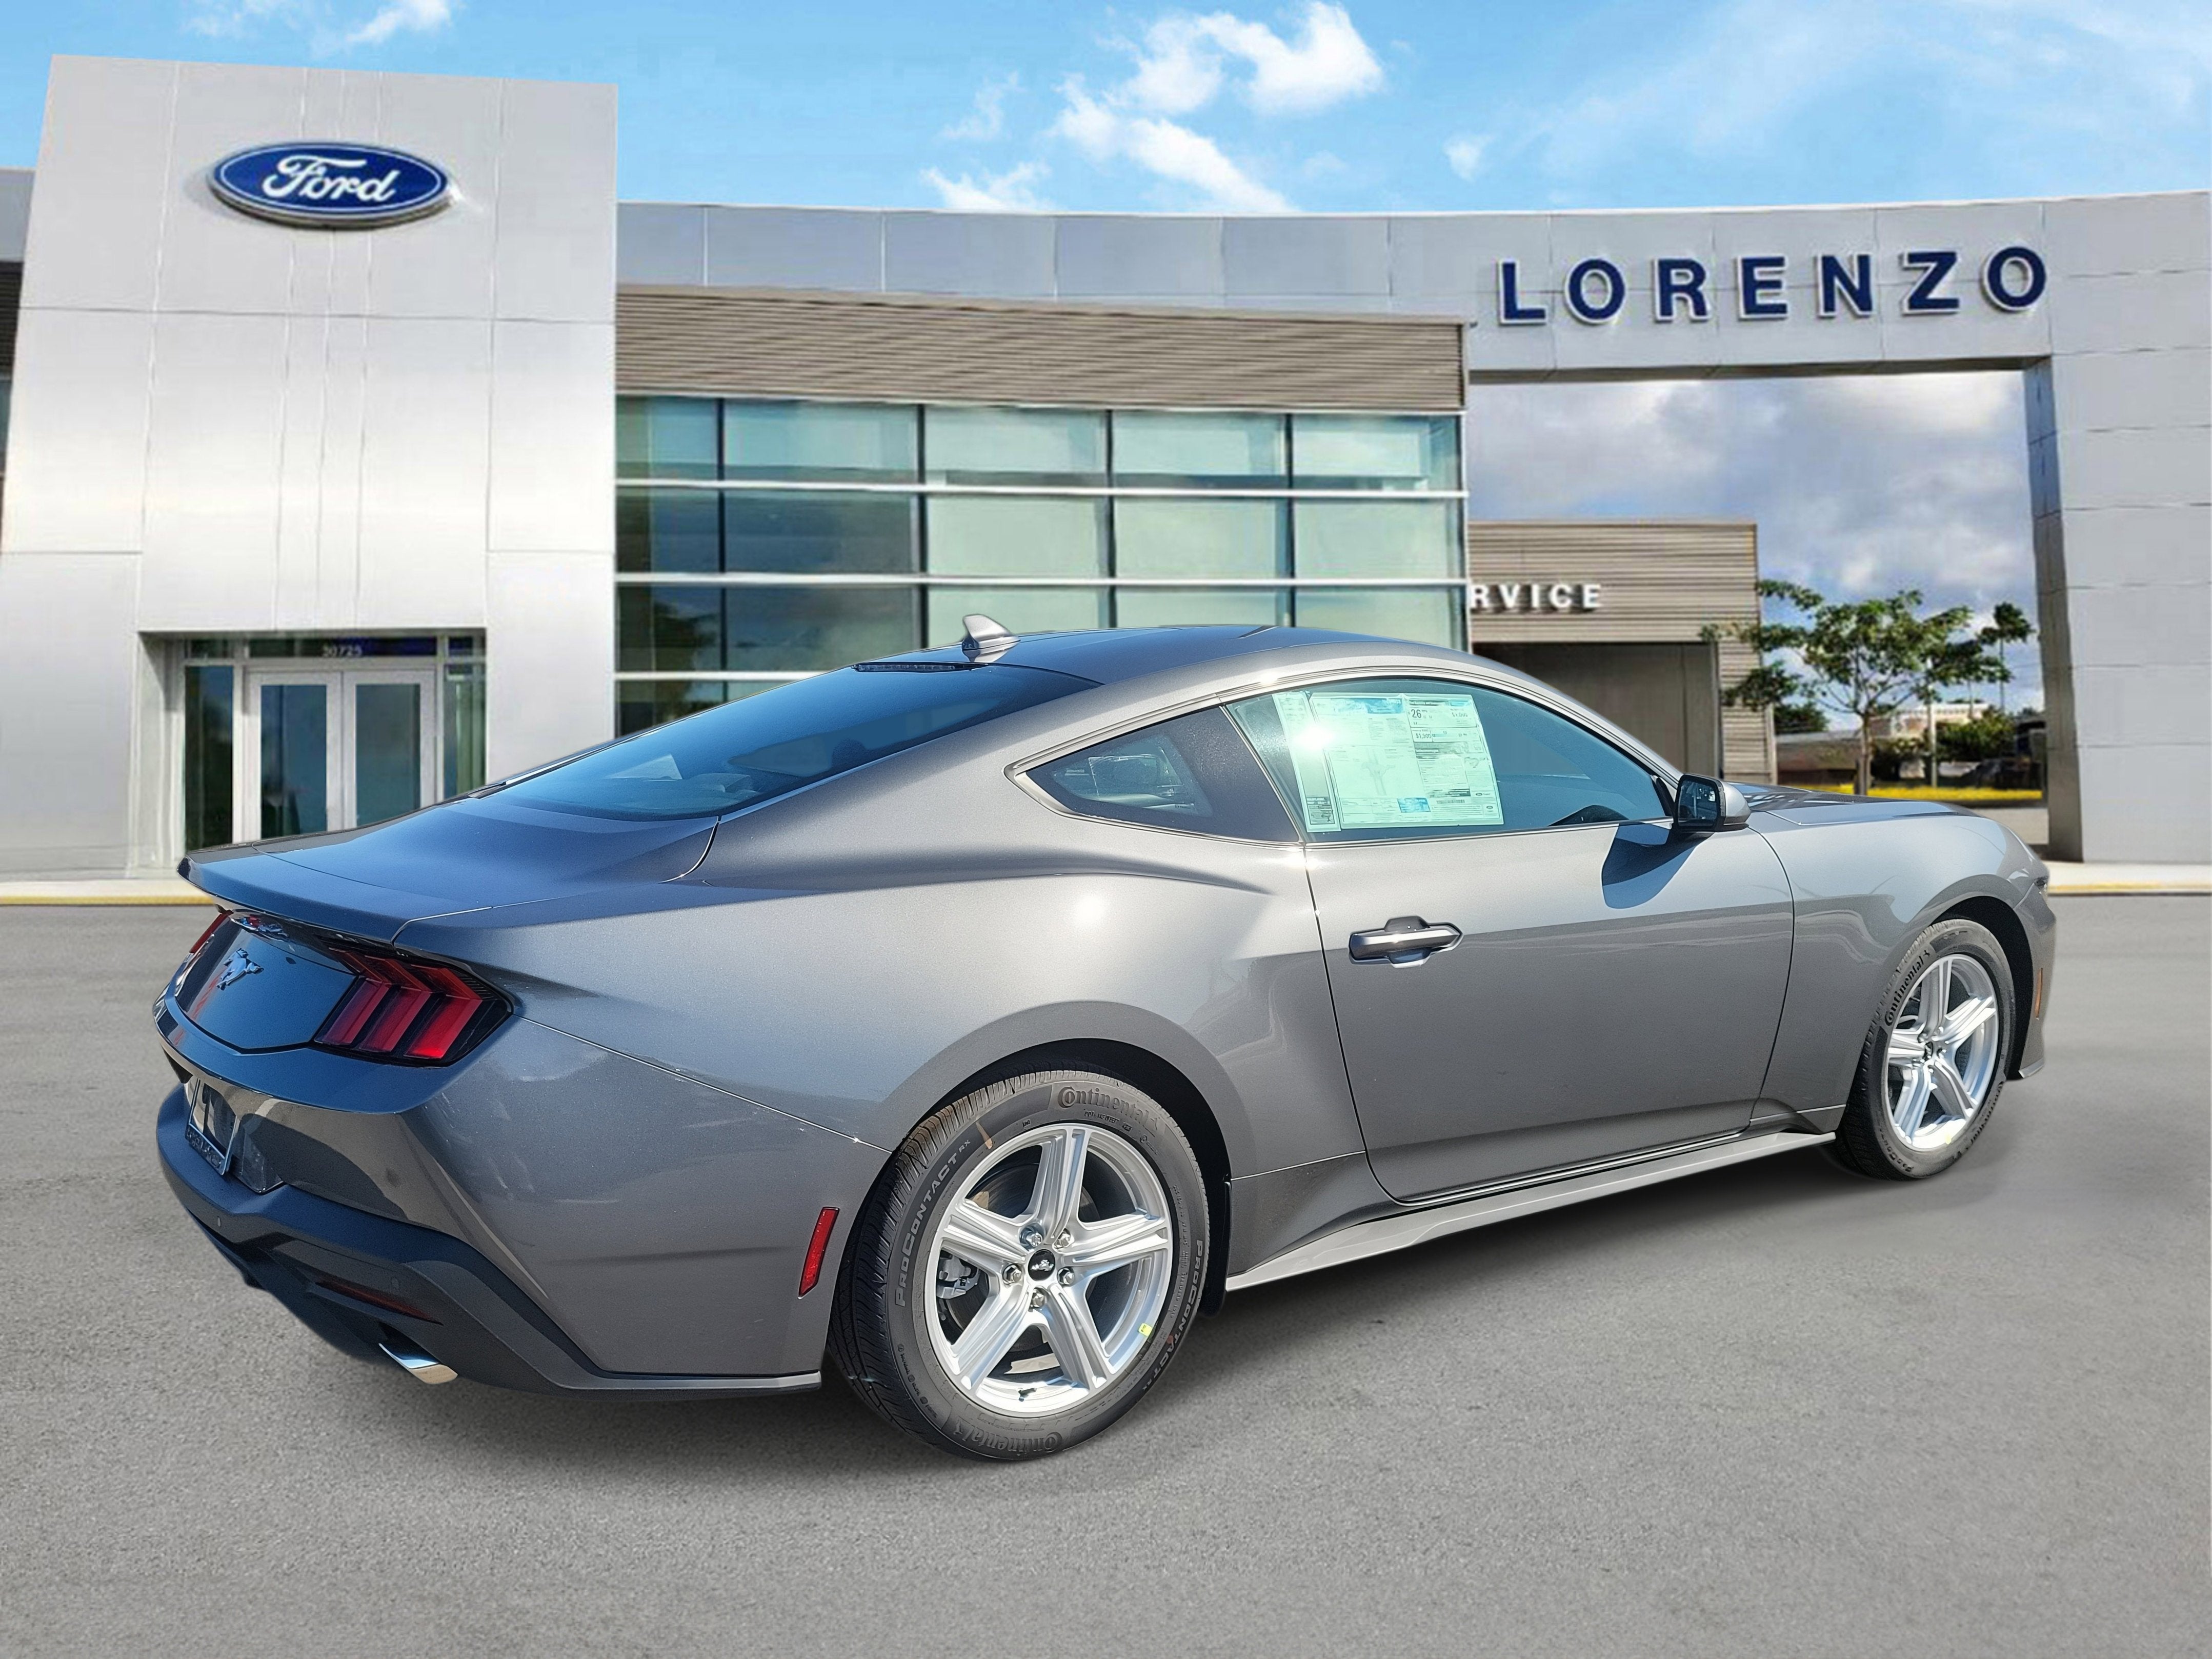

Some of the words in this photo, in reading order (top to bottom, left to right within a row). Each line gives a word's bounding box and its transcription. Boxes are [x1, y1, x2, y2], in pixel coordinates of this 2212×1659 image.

[262, 155, 400, 202] Ford
[1499, 247, 2046, 323] LORENZO
[1411, 709, 1421, 718] 26
[1885, 955, 1924, 1026] Continental
[1057, 1086, 1150, 1127] Continental
[895, 1153, 957, 1307] PROCONTACT
[958, 1139, 971, 1153] RX
[961, 1427, 1063, 1456] Continental
